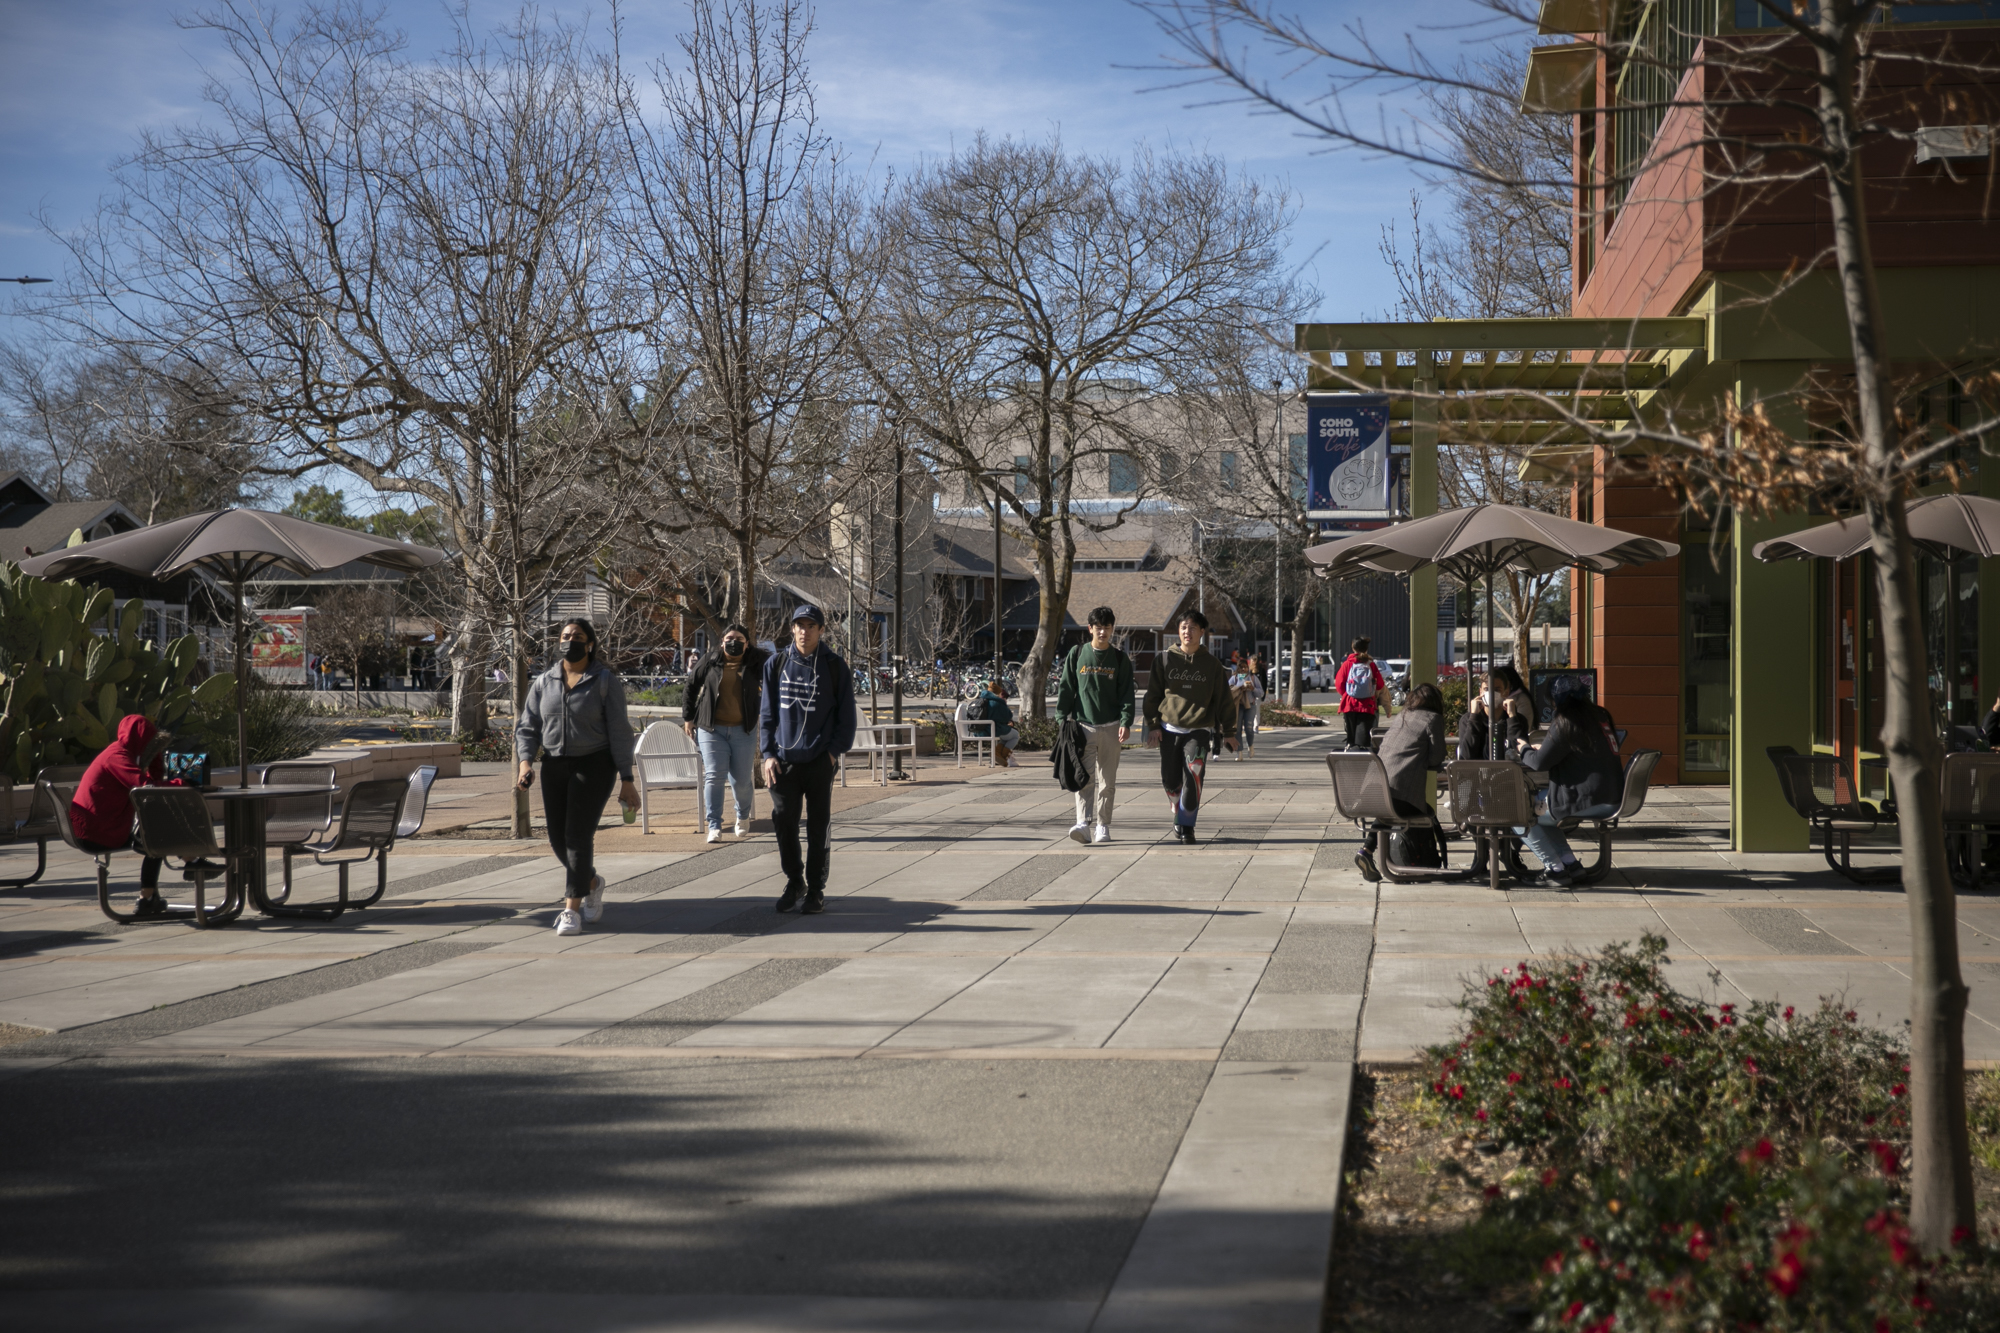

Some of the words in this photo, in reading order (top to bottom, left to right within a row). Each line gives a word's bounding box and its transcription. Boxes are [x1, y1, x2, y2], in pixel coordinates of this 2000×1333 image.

[1319, 418, 1353, 427] COHO
[1319, 428, 1359, 437] SOUTH
[1324, 435, 1361, 461] Café
